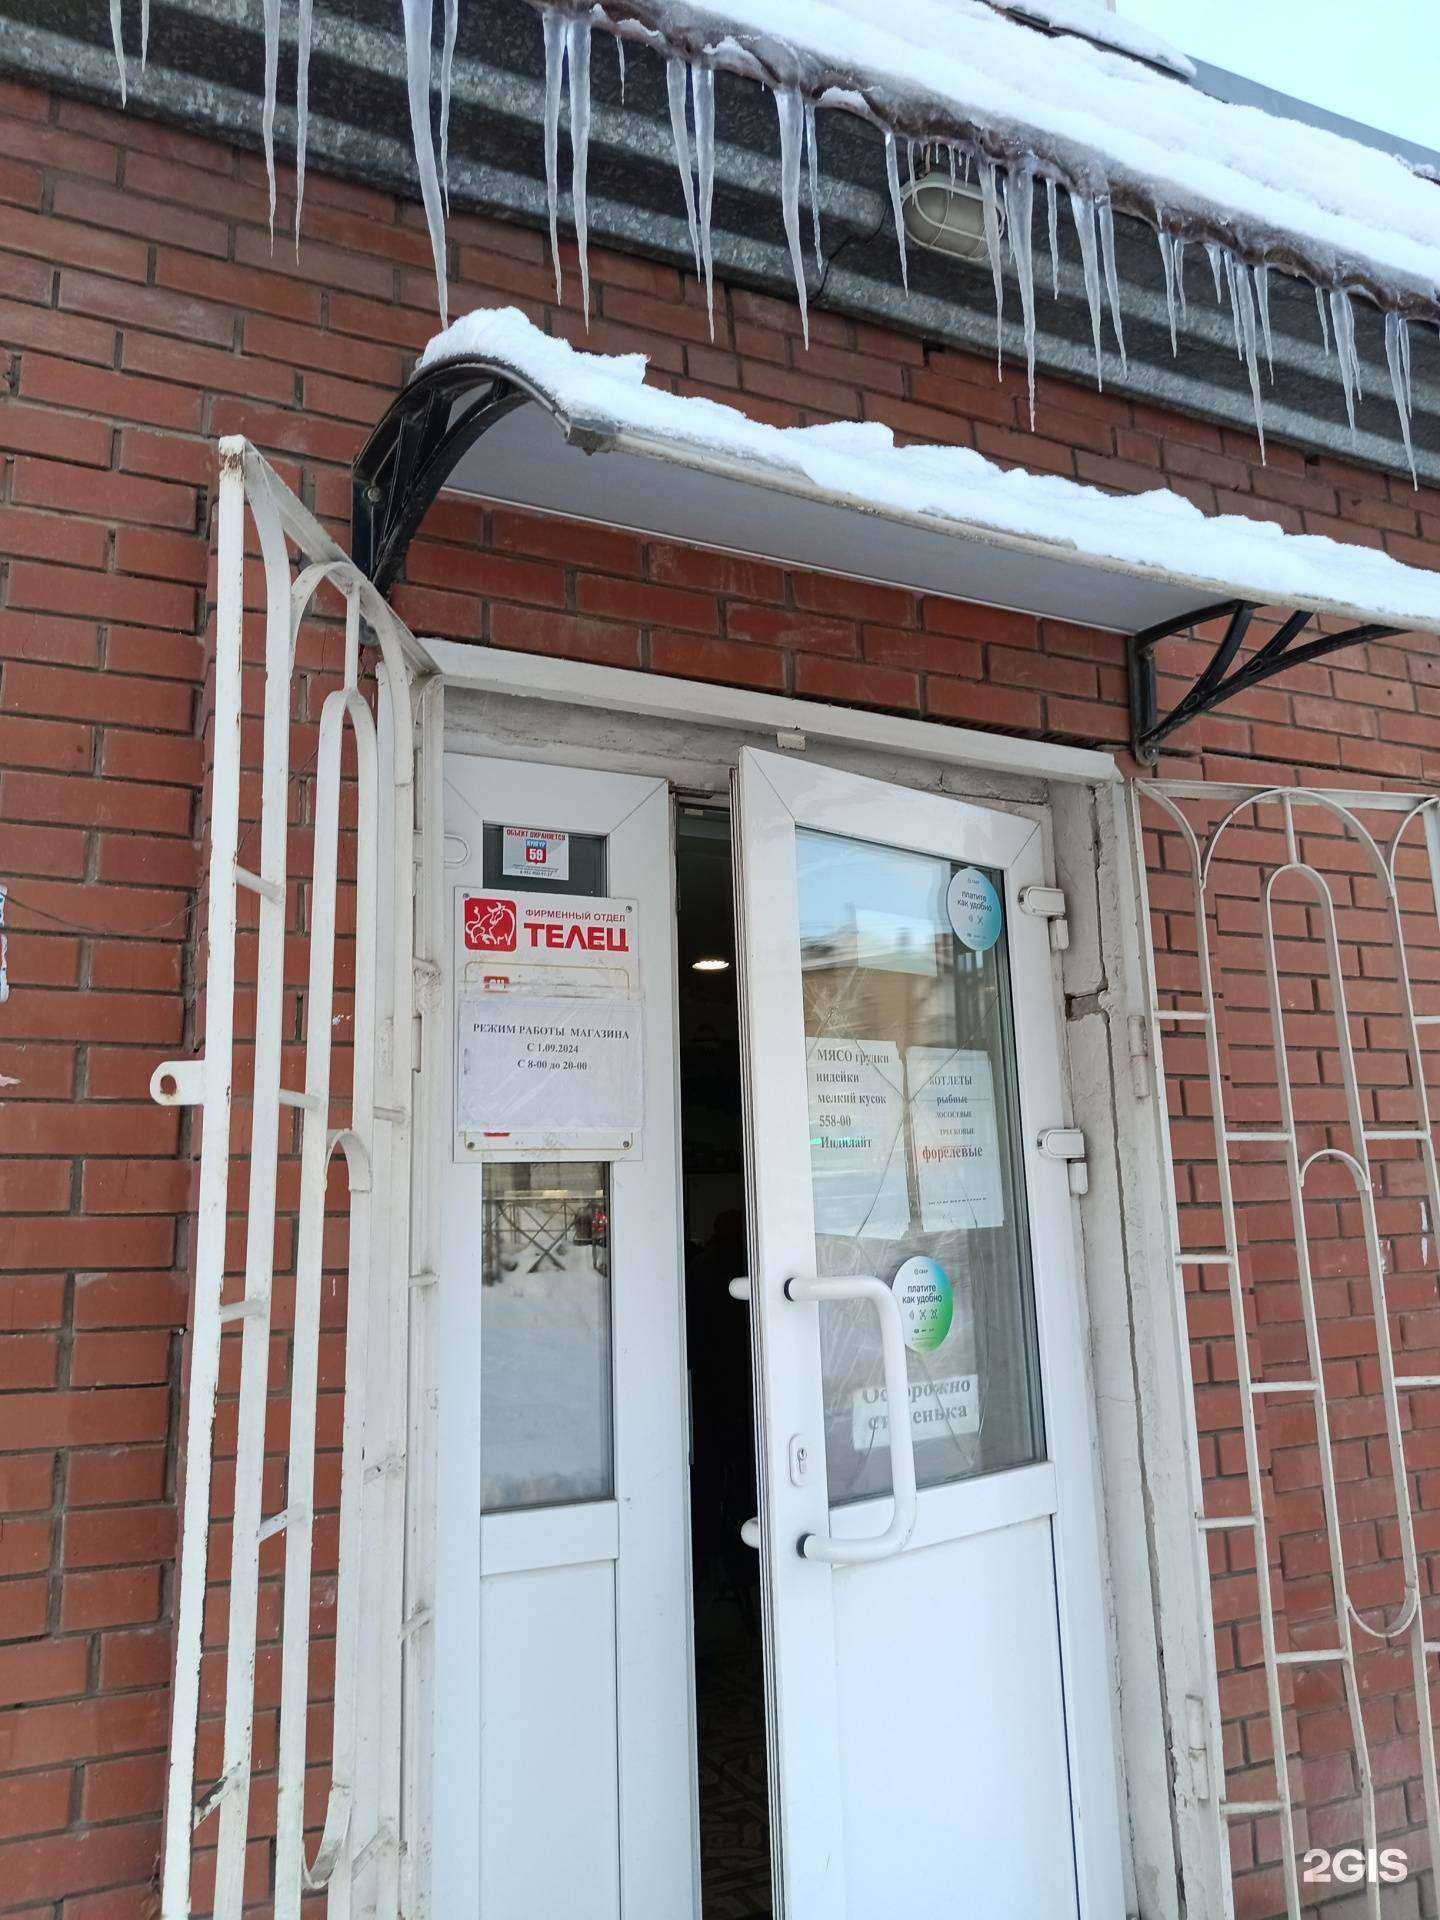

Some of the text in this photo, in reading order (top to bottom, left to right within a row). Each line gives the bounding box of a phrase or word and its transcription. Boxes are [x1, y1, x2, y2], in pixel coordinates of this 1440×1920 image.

[525, 908, 626, 923] ФИРМЕННЫЙ ОТДЕЛ
[523, 922, 629, 952] ТЕЛЕЦ
[473, 1023, 630, 1040] РЕЖИМ РАБОТЫ МАГАЗИНА
[526, 1042, 579, 1054] С 1.09.2024
[517, 1059, 588, 1071] С 8-00 до 20-00
[817, 1048, 890, 1067] МЯСО грудки
[815, 1070, 861, 1084] индейки
[817, 1092, 888, 1108] мелкий кусок
[936, 1094, 969, 1108] рыбные
[819, 1113, 852, 1128] 558-00
[922, 1145, 984, 1164] форелевые
[907, 1284, 937, 1294] платите
[902, 1292, 943, 1306] как удобно
